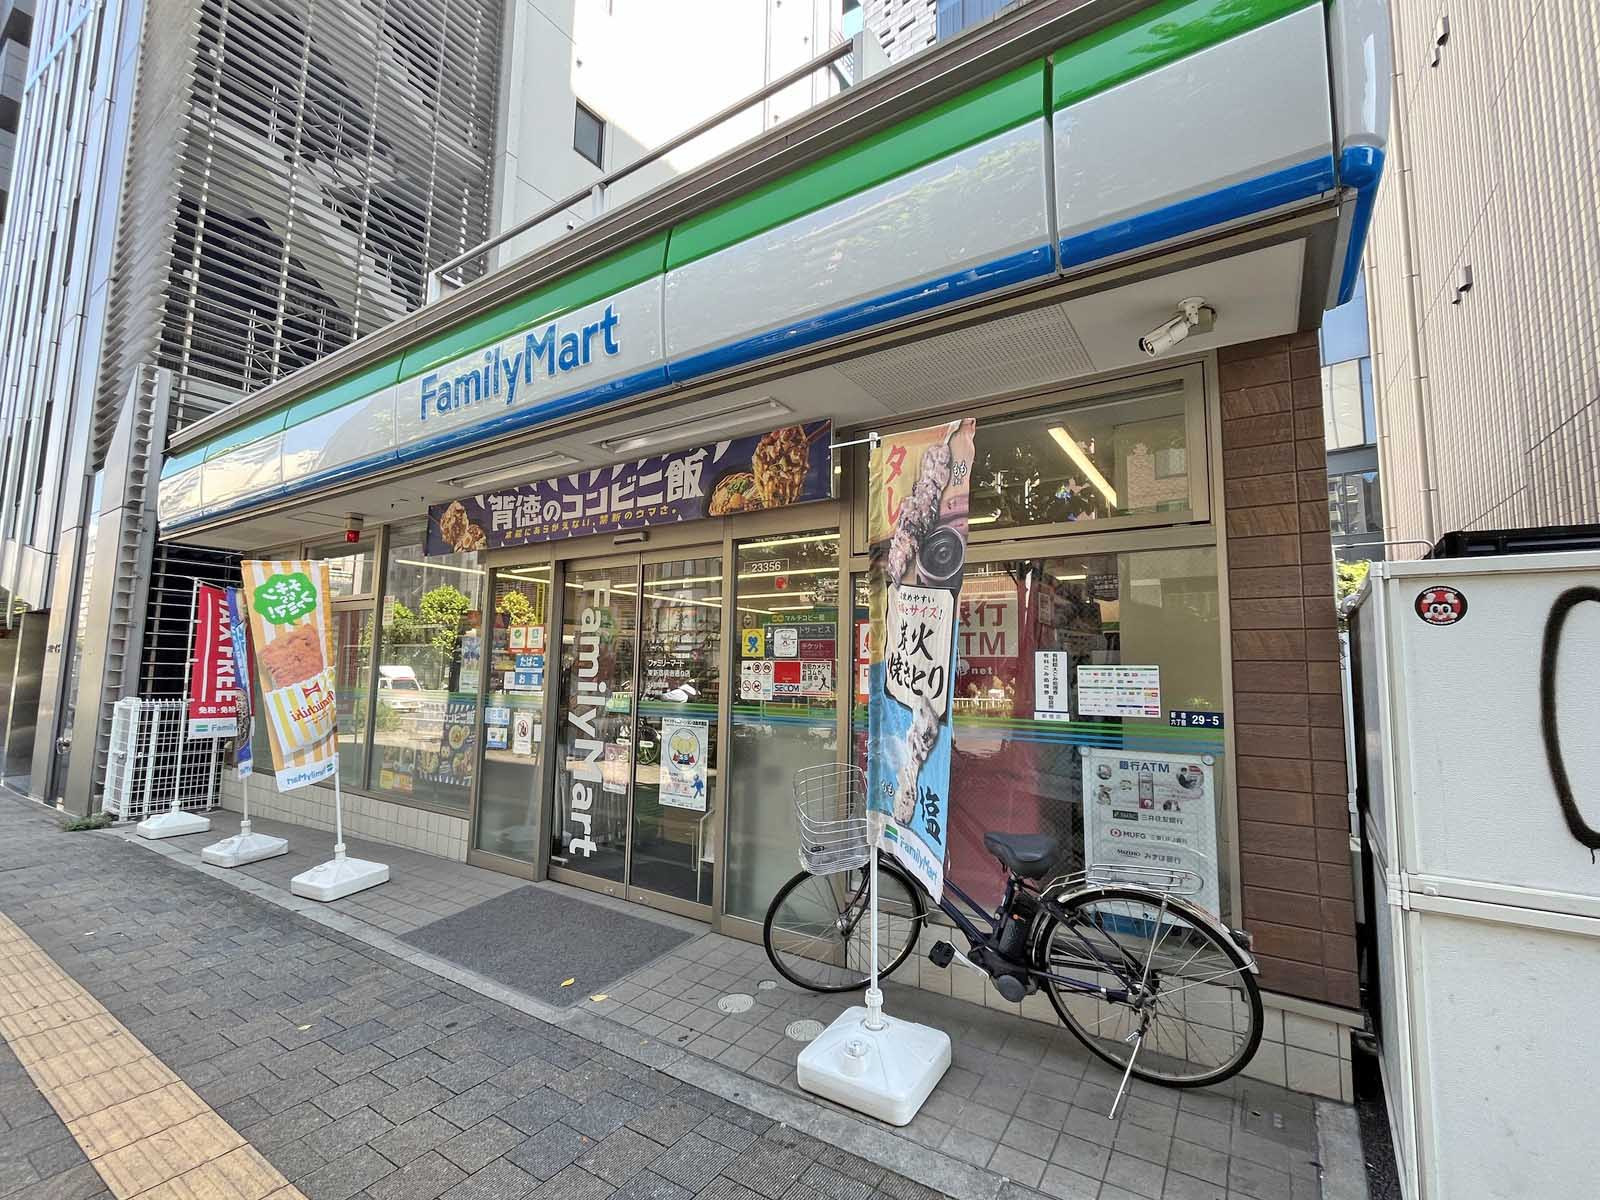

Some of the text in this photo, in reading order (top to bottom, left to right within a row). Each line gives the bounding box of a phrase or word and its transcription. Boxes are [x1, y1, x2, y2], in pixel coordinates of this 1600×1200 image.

[420, 304, 619, 420] FamilyMart
[488, 450, 705, 531] 背徳のコンビニ飯
[885, 445, 907, 527] タレ
[751, 562, 781, 573] 23356
[959, 631, 1005, 655] TM
[519, 656, 539, 667] たばこ
[648, 659, 685, 667] ファミリーマート
[888, 651, 944, 699] 焼きとり
[774, 684, 800, 692] SECOM
[568, 580, 610, 857] FamilyMart
[1191, 714, 1220, 726] 29-5
[919, 785, 942, 846] 塩
[1123, 831, 1146, 840] MUFG
[899, 837, 938, 884] FamilyMart
